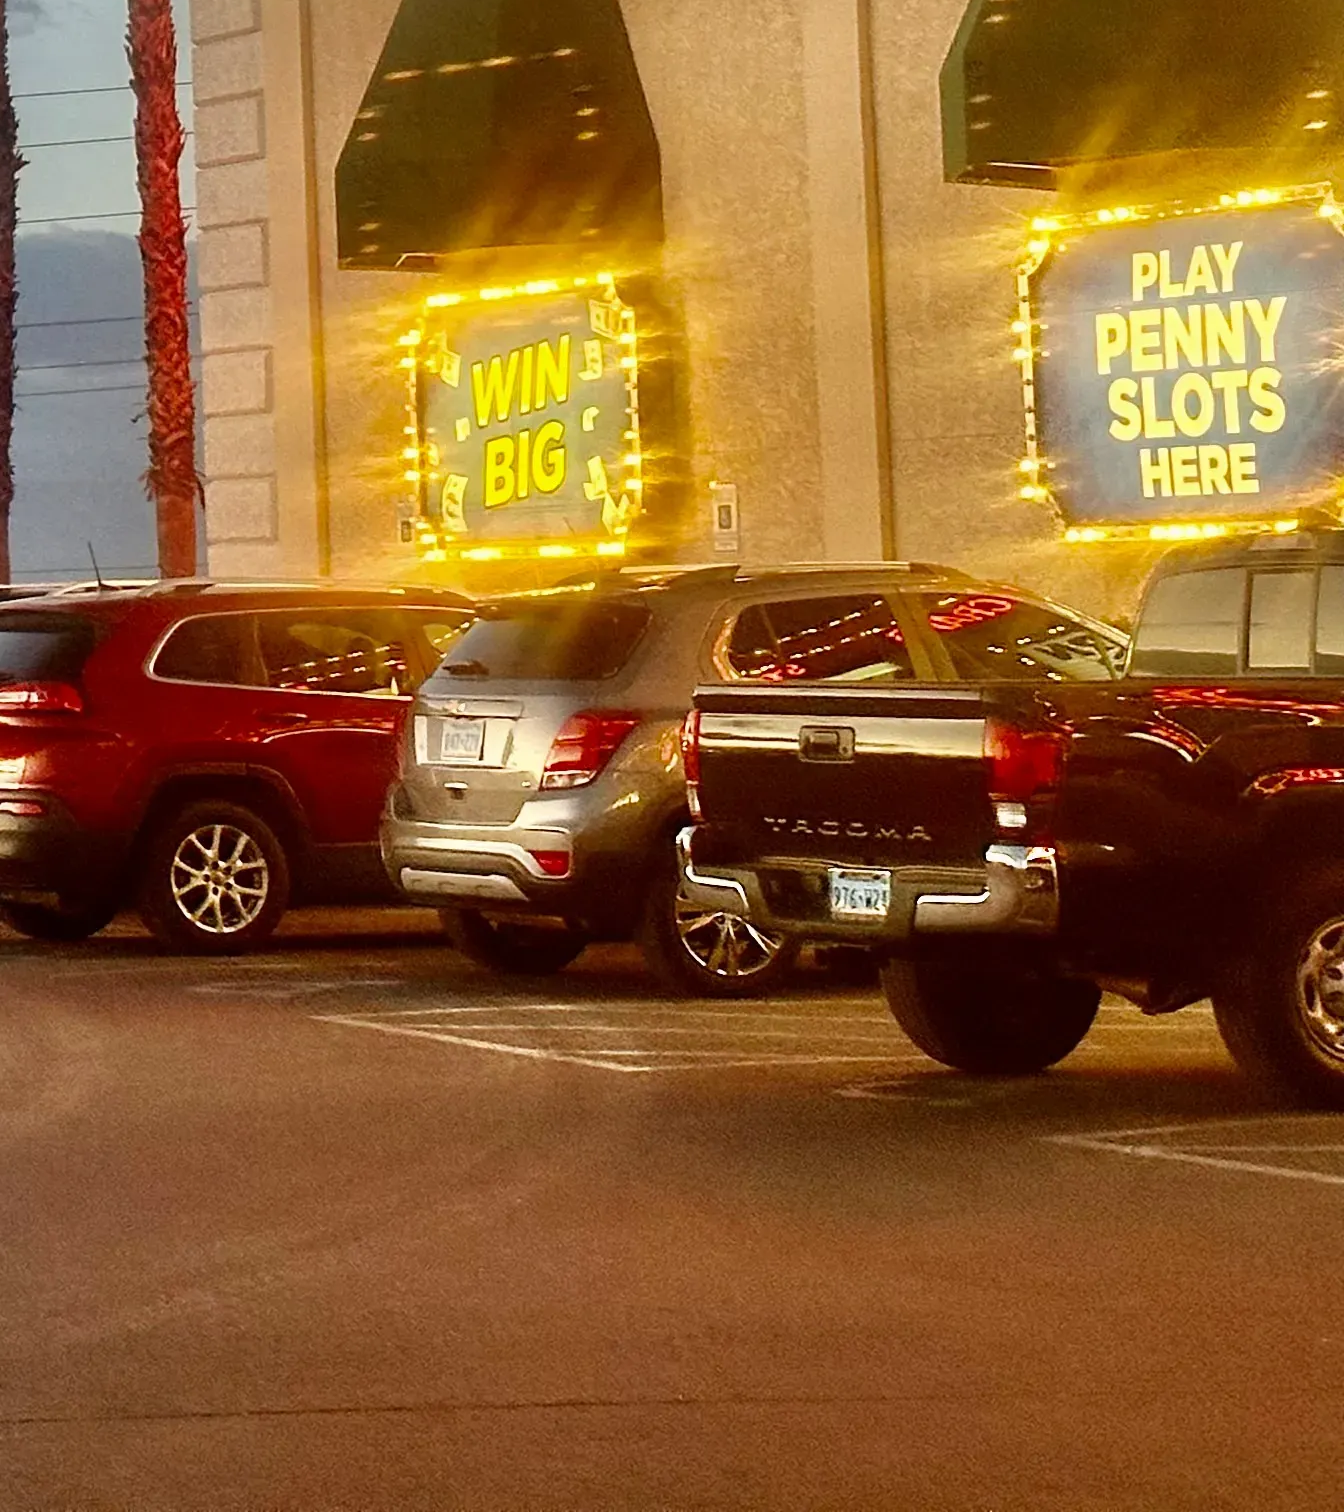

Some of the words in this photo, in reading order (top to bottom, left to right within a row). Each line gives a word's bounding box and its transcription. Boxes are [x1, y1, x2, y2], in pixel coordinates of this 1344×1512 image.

[1131, 241, 1244, 302] PLAY
[1095, 296, 1288, 376] PENNY
[470, 333, 571, 429] WIN
[1107, 366, 1287, 442] SLOTS
[483, 418, 568, 510] BIG
[1138, 442, 1260, 499] HERE
[763, 816, 934, 842] TACOMA
